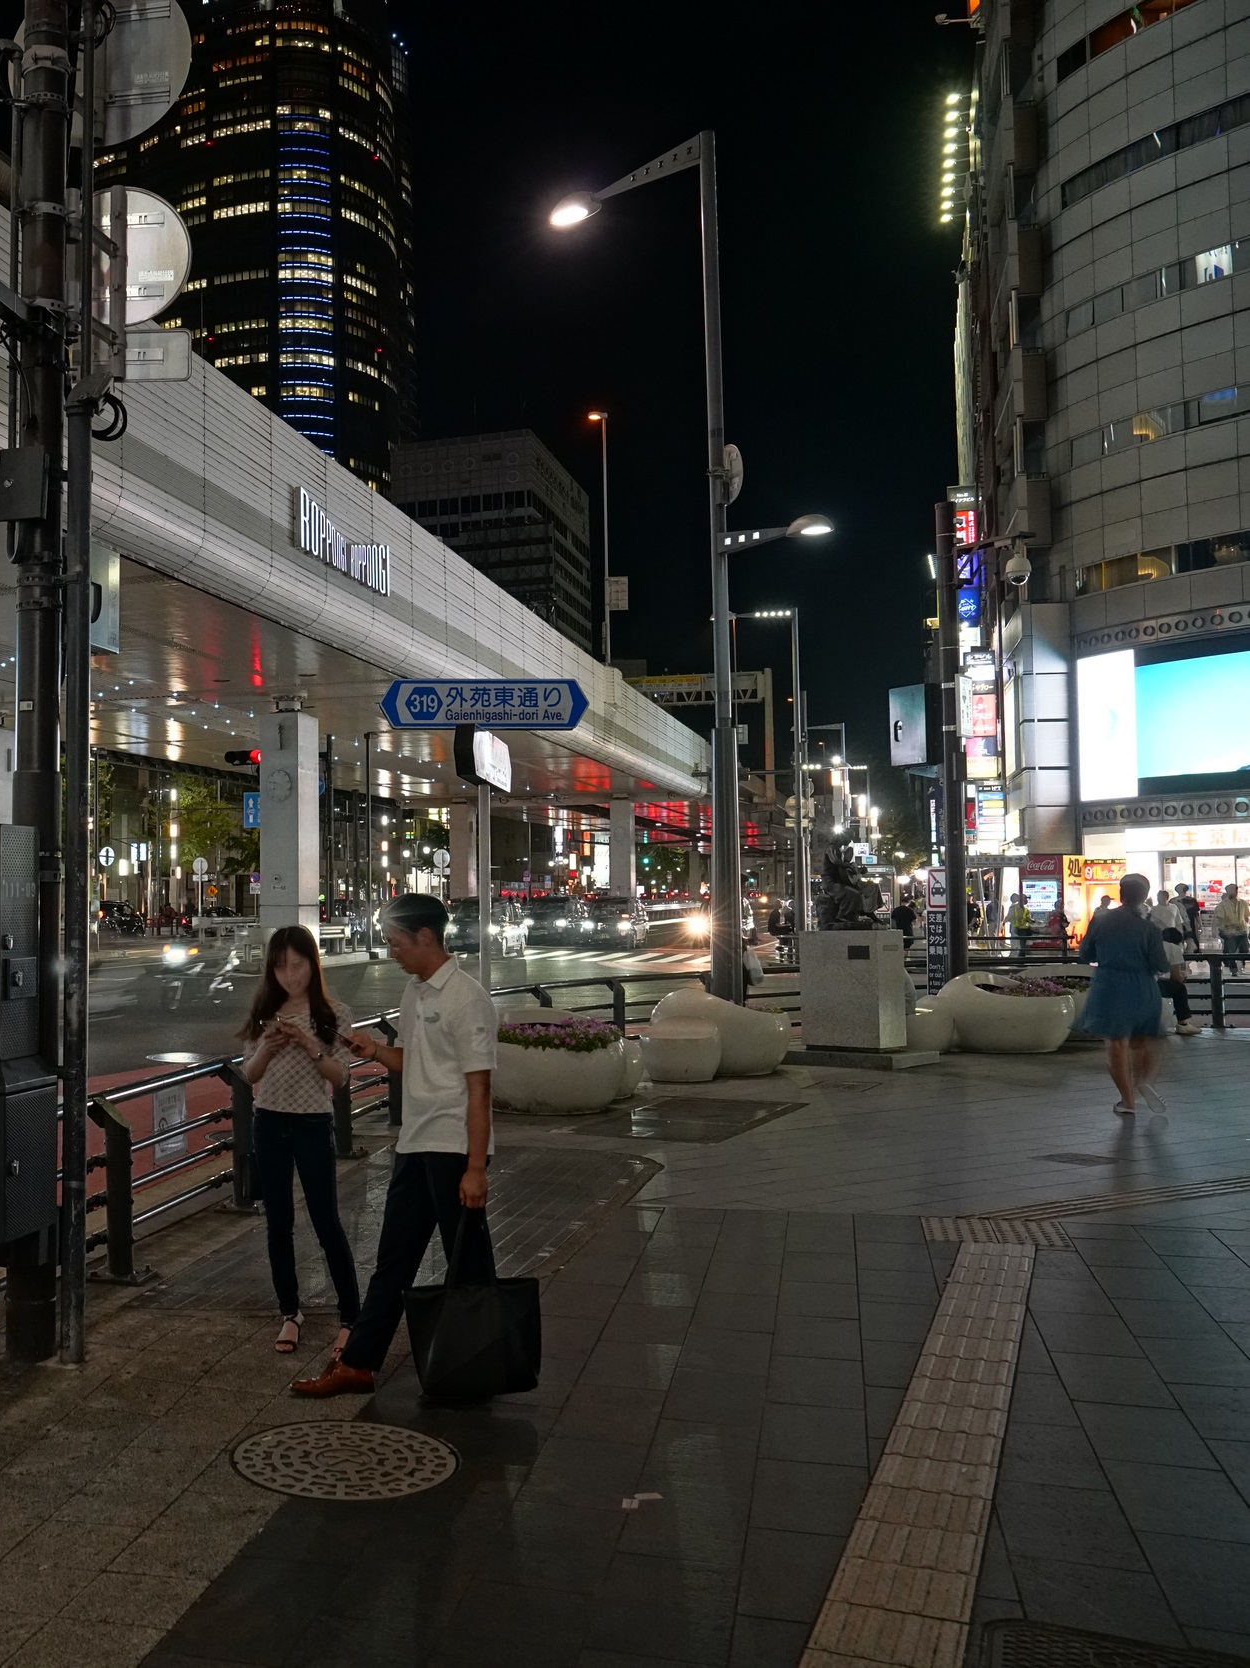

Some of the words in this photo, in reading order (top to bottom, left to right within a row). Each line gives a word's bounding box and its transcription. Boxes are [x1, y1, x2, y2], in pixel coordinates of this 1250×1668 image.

[300, 486, 347, 573] ROPPONGI
[350, 544, 390, 597] ROPPONGI
[410, 694, 438, 713] 319
[445, 686, 562, 709] 外苑東通り
[445, 709, 539, 722] Gaienhigashi-dori
[542, 709, 565, 721] Ave.
[928, 925, 943, 934] では
[928, 935, 947, 945] タクシ
